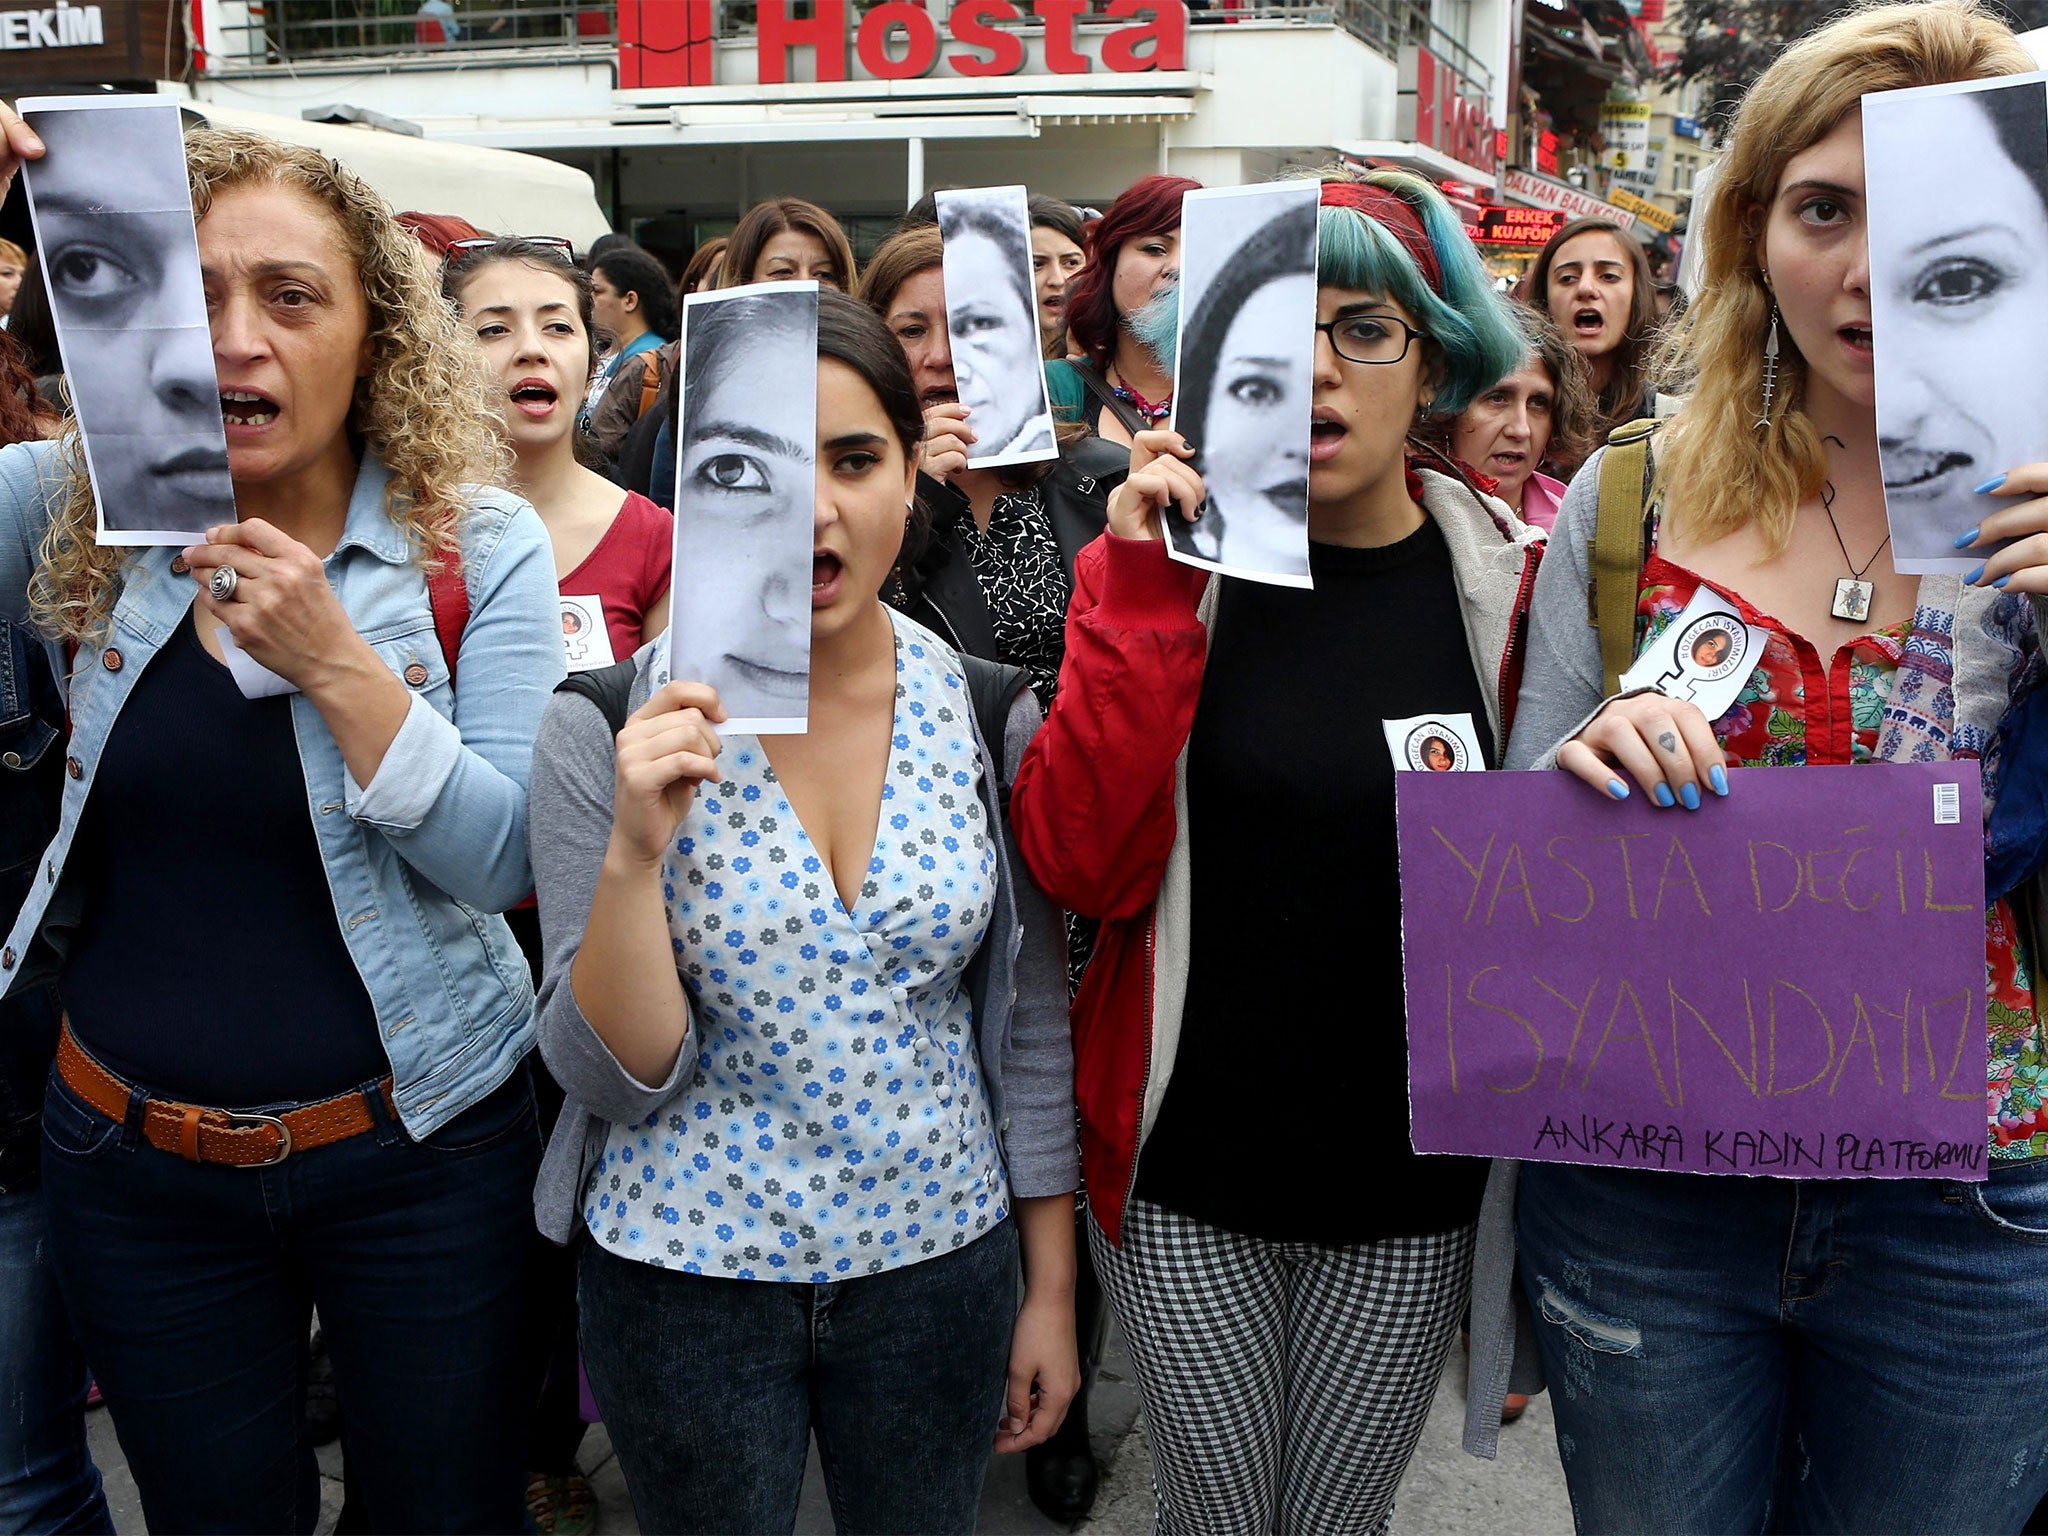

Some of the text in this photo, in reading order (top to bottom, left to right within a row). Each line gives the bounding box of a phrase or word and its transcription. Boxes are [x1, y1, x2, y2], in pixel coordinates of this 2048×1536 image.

[758, 0, 1189, 83] Hosta
[1505, 170, 1559, 203] DALYAN
[1505, 210, 1554, 225] ERKEK
[1431, 826, 1712, 925] YASTA
[1446, 964, 1985, 1107] ISYANDAYIZ
[1533, 1115, 1984, 1172] ANKARA KADIN PLATFORMU
